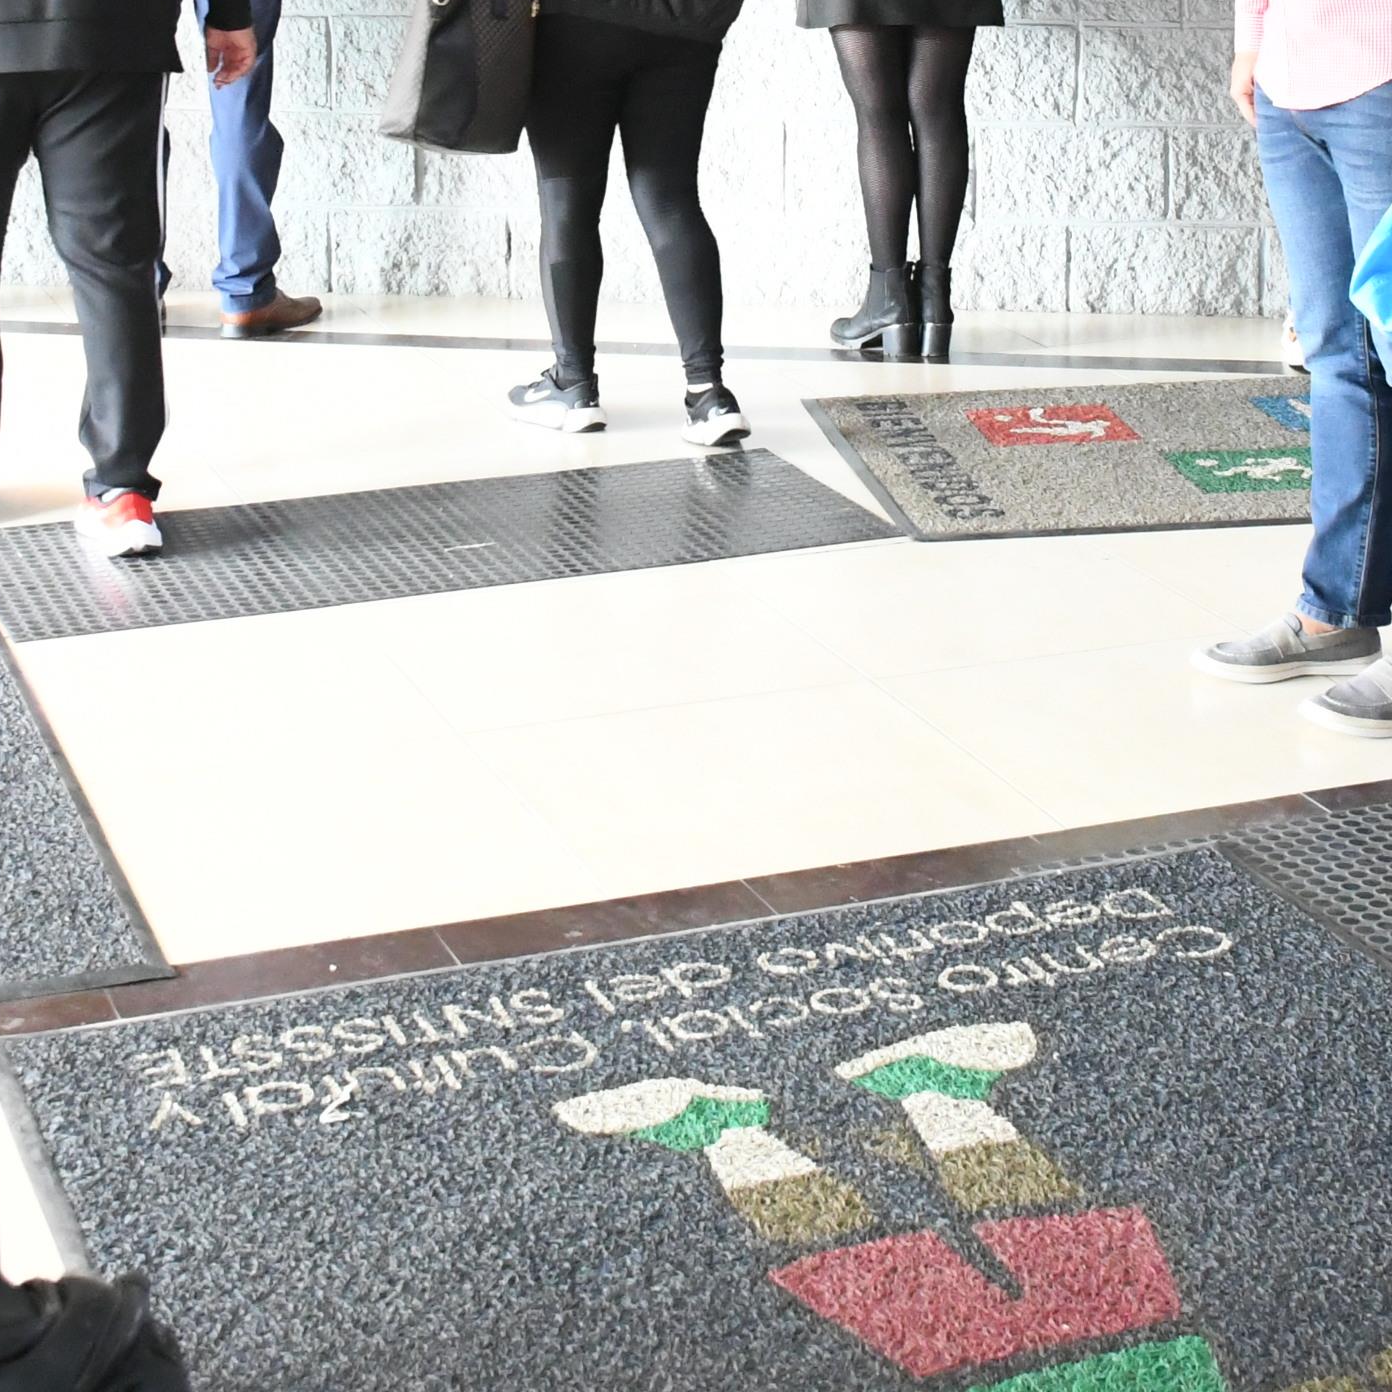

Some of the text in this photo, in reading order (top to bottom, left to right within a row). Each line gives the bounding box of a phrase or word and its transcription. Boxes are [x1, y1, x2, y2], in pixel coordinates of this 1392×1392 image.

[130, 887, 1175, 1089] Deportivo del SNTISSSTE
[938, 925, 1234, 990] Centro
[222, 1031, 598, 1127] Cultural
